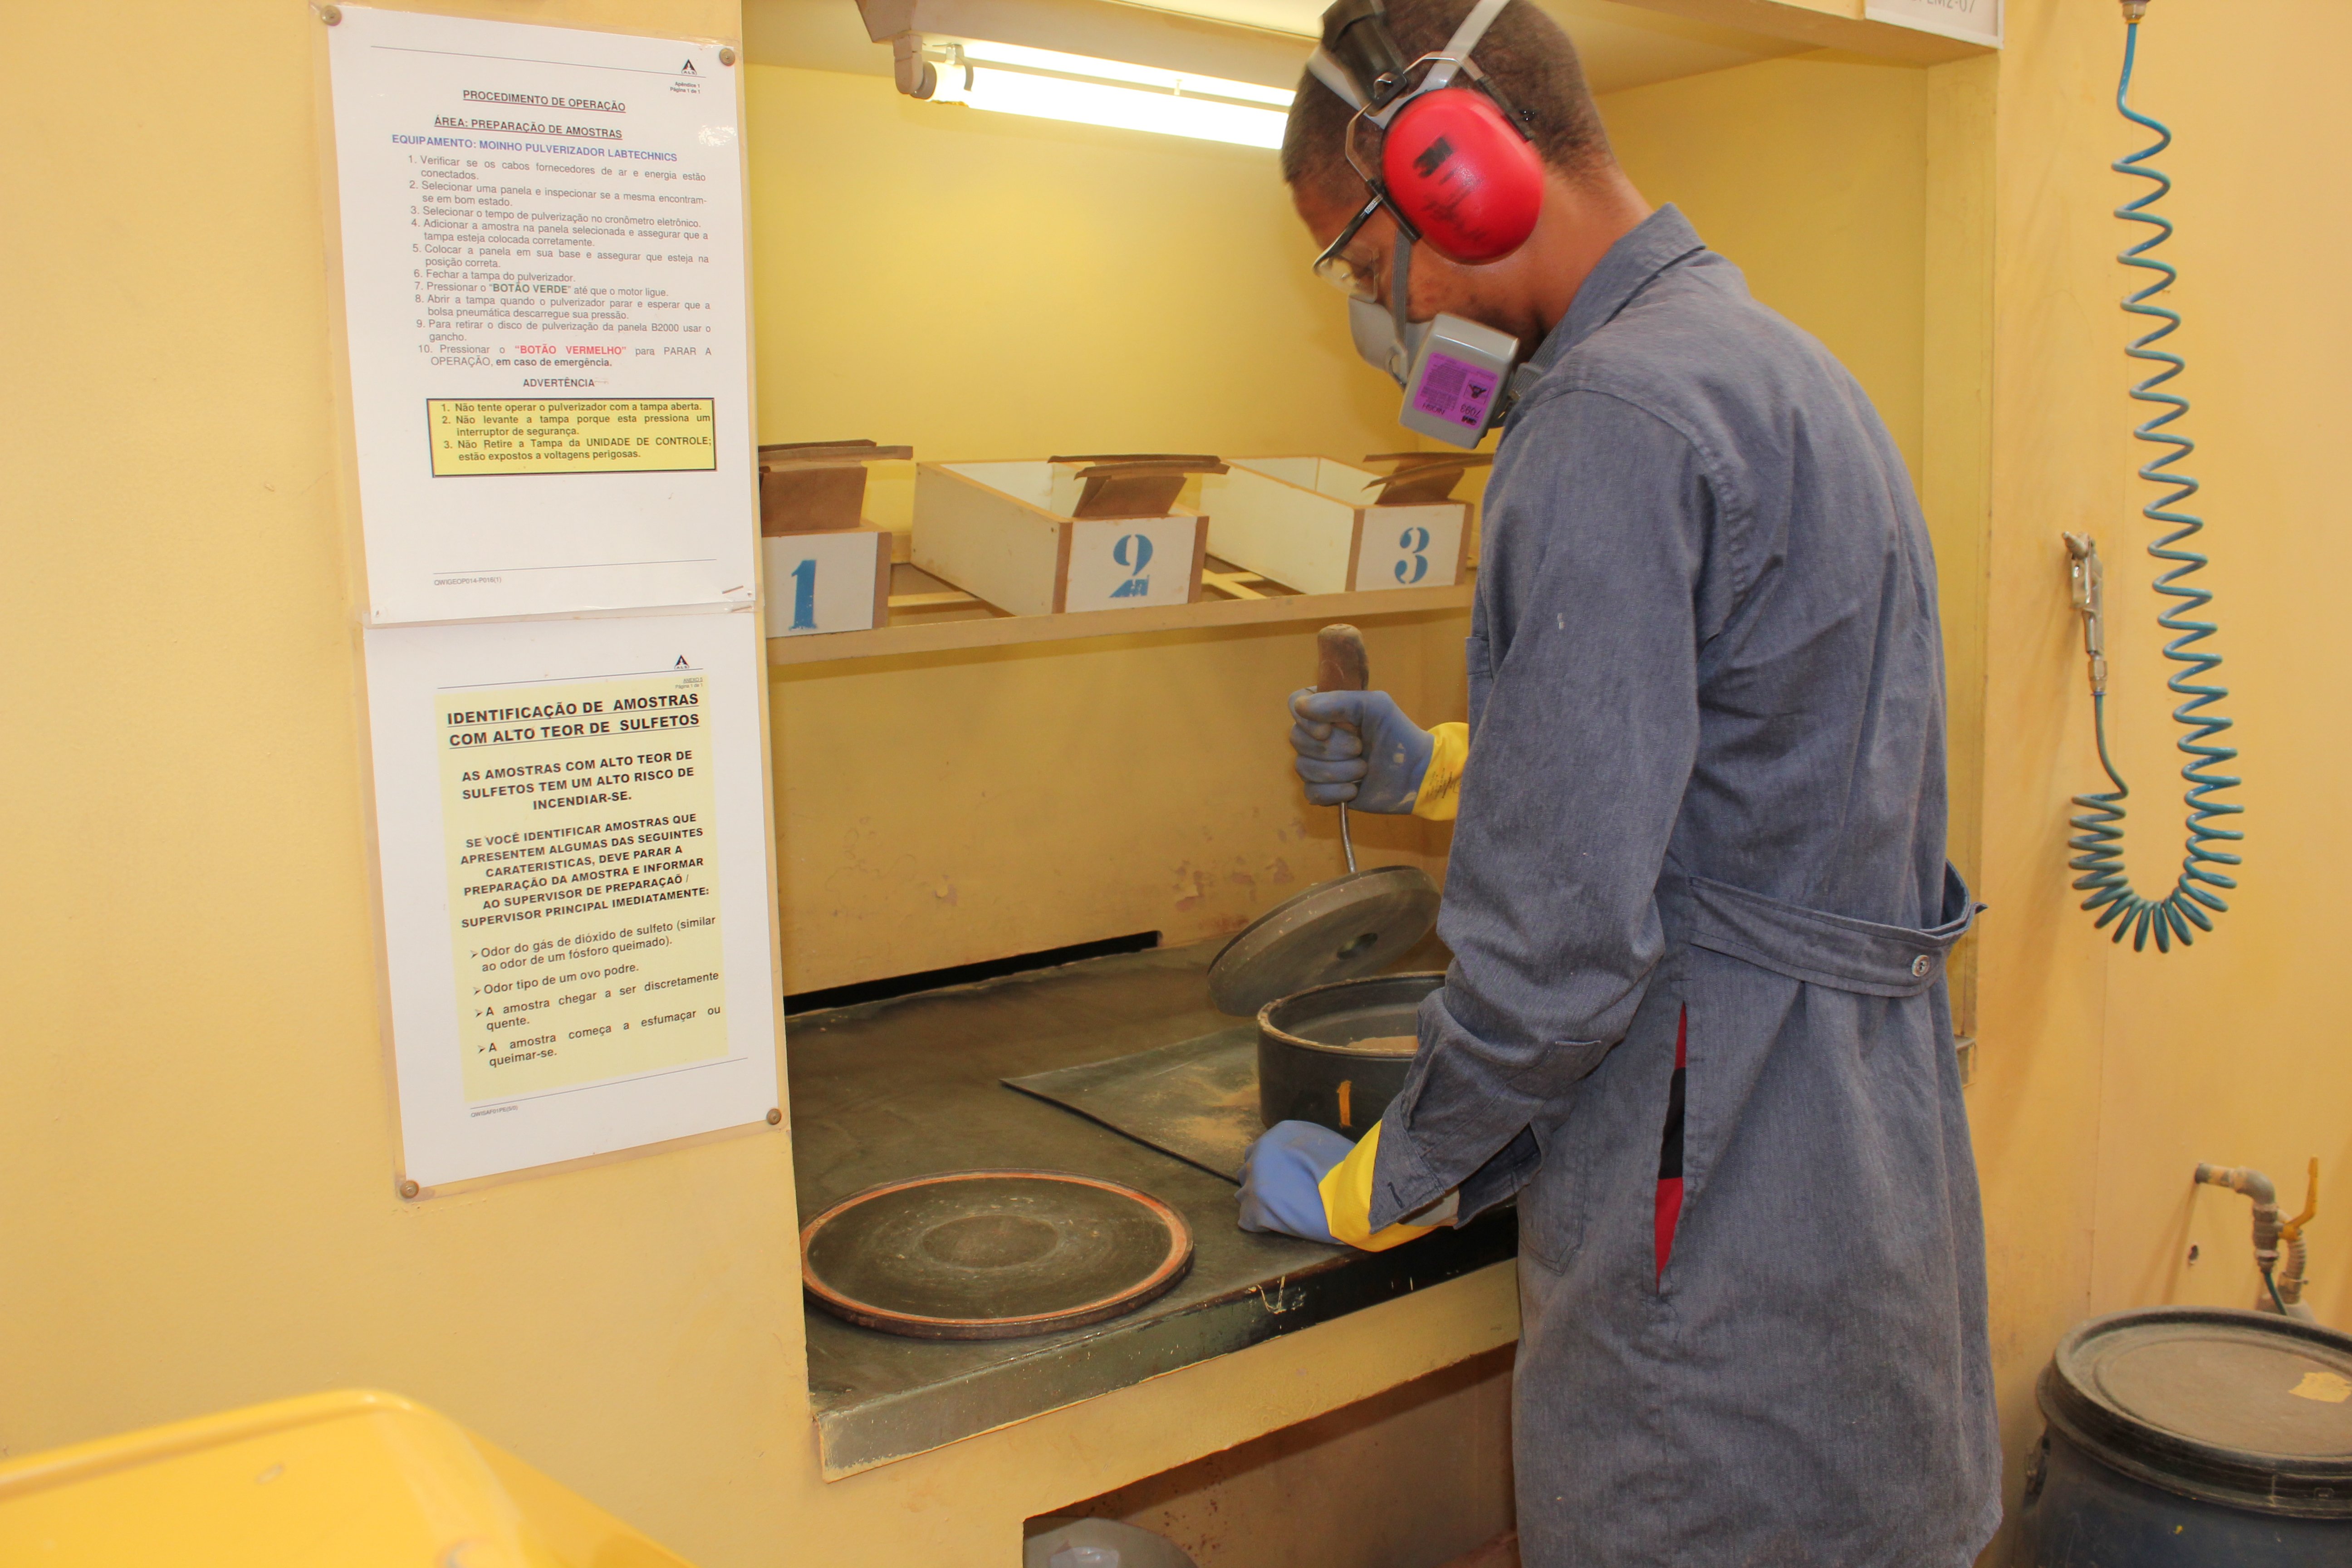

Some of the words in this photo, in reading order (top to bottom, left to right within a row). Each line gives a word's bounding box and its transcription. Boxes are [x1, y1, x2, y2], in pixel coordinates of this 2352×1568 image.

[463, 90, 549, 105] PROCEDIMENTO
[551, 97, 566, 106] DE
[568, 98, 626, 111] OPERAÇÃO
[434, 115, 468, 127] ÁREA:
[471, 119, 546, 133] PREPARAÇÃO
[549, 124, 563, 134] DE
[566, 126, 622, 138] AMOSTRAS
[392, 134, 476, 149] EQUIPAMENTO:
[479, 140, 523, 152] MOINHO
[525, 143, 605, 157] PULVERIZADOR
[608, 149, 677, 162] LABTECHNICS
[436, 196, 452, 204] em
[454, 195, 475, 205] bom
[478, 197, 513, 206] estado.
[424, 231, 455, 243] tampa
[456, 233, 486, 245] esteja
[488, 234, 530, 245] colocada
[532, 237, 595, 247] corretamente.
[425, 257, 463, 269] posição
[465, 259, 501, 268] correta.
[427, 307, 454, 316] bolsa
[456, 308, 511, 318] pneumática
[513, 309, 570, 320] descarregue
[591, 310, 629, 321] pressão.
[419, 344, 432, 353] 10.
[440, 344, 490, 354] Pressionar
[635, 348, 655, 357] para
[664, 347, 696, 355] PARAR
[705, 347, 712, 356] A
[431, 356, 493, 368] OPERAÇÃO,
[539, 357, 552, 367] de
[554, 358, 612, 368] emergência.
[523, 377, 595, 387] ADVERTÊNCIA
[441, 403, 450, 412] 1.
[455, 403, 475, 412] Não
[477, 403, 502, 412] tente
[505, 404, 537, 414] operar
[548, 402, 607, 413] pulverizador
[640, 403, 668, 413] tampa
[671, 402, 702, 411] aberta.
[1422, 402, 1445, 415] NIOSH
[1460, 403, 1481, 418] 7093
[456, 427, 510, 438] interruptor
[512, 427, 524, 436] de
[526, 428, 579, 438] segurança.
[458, 452, 486, 461] estão
[488, 451, 534, 462] expostos
[544, 451, 590, 461] voltagens
[593, 450, 641, 461] perigosas.
[1108, 534, 1153, 598] 2
[1394, 526, 1430, 584] 3
[788, 559, 818, 631] 1
[448, 702, 577, 725] IDENTIFICAÇÃO
[583, 701, 603, 714] DE
[613, 693, 699, 711] AMOSTRAS
[450, 732, 487, 746] COM
[493, 728, 535, 743] ALTO
[540, 724, 584, 738] TEOR
[589, 721, 610, 734] DE
[620, 714, 699, 731] SULFETOS
[462, 770, 480, 782] AS
[485, 763, 561, 779] AMOSTRAS
[566, 760, 595, 771] COM
[600, 756, 633, 768] ALTO
[637, 752, 672, 764] TEOR
[676, 750, 692, 761] DE
[462, 783, 534, 799] SULFETOS
[538, 780, 567, 792] TEM
[571, 777, 592, 789] UM
[596, 774, 630, 786] ALTO
[634, 769, 674, 782] RISCO
[677, 767, 694, 778] DE
[533, 791, 632, 810] INCENDIAR-SE.
[466, 838, 482, 848] SE
[485, 832, 520, 846] VOCÊ
[524, 824, 601, 842] IDENTIFICAR
[605, 816, 669, 832] AMOSTRAS
[672, 813, 696, 824] QUE
[461, 847, 545, 865] APRESENTEM
[549, 839, 608, 854] ALGUMAS
[611, 836, 634, 847] DAS
[638, 828, 704, 843] SEGUINTES
[485, 856, 595, 877] CARATERISTICAS,
[599, 852, 630, 863] DEVE
[633, 847, 671, 859] PARAR
[675, 845, 683, 854] A
[464, 877, 548, 896] PREPARAÇÃO
[551, 875, 568, 885] DA
[571, 867, 629, 882] AMOSTRA
[632, 866, 640, 875] E
[643, 858, 704, 873] INFORMAR
[461, 909, 542, 928] SUPERVISOR
[545, 901, 609, 917] PRINCIPAL
[612, 887, 709, 908] IMEDIATAMENTE:
[483, 899, 500, 910] AO
[504, 888, 583, 906] SUPERVISOR
[586, 886, 602, 896] DE
[481, 946, 510, 958] Odor
[514, 943, 529, 953] do
[533, 939, 554, 953] gás
[557, 936, 571, 947] de
[574, 930, 616, 945] dióxido
[619, 928, 633, 938] de
[637, 922, 673, 936] sulfeto
[676, 916, 716, 931] (similar
[482, 963, 497, 972] ao
[500, 958, 527, 970] odor
[530, 955, 544, 965] de
[548, 953, 566, 963] um
[568, 946, 609, 959] fósforo
[612, 936, 672, 955] queimado).
[484, 982, 513, 994] Odor
[516, 979, 539, 991] tipo
[542, 975, 556, 986] de
[559, 973, 577, 983] um
[580, 970, 601, 980] ovo
[604, 964, 639, 979] podre.
[485, 1006, 495, 1017] A
[503, 1000, 550, 1014] amostra
[558, 992, 597, 1005] chegar
[605, 990, 611, 998] a
[619, 986, 637, 995] ser
[644, 972, 719, 991] discretamente
[486, 1017, 530, 1032] quente.
[488, 1042, 497, 1053] A
[510, 1034, 556, 1049] amostra
[568, 1025, 612, 1039] começa
[623, 1022, 630, 1030] a
[641, 1010, 696, 1027] esfumaçar
[707, 1006, 720, 1015] ou
[489, 1049, 557, 1068] queimar-se.
[1337, 1079, 1352, 1128] 1
